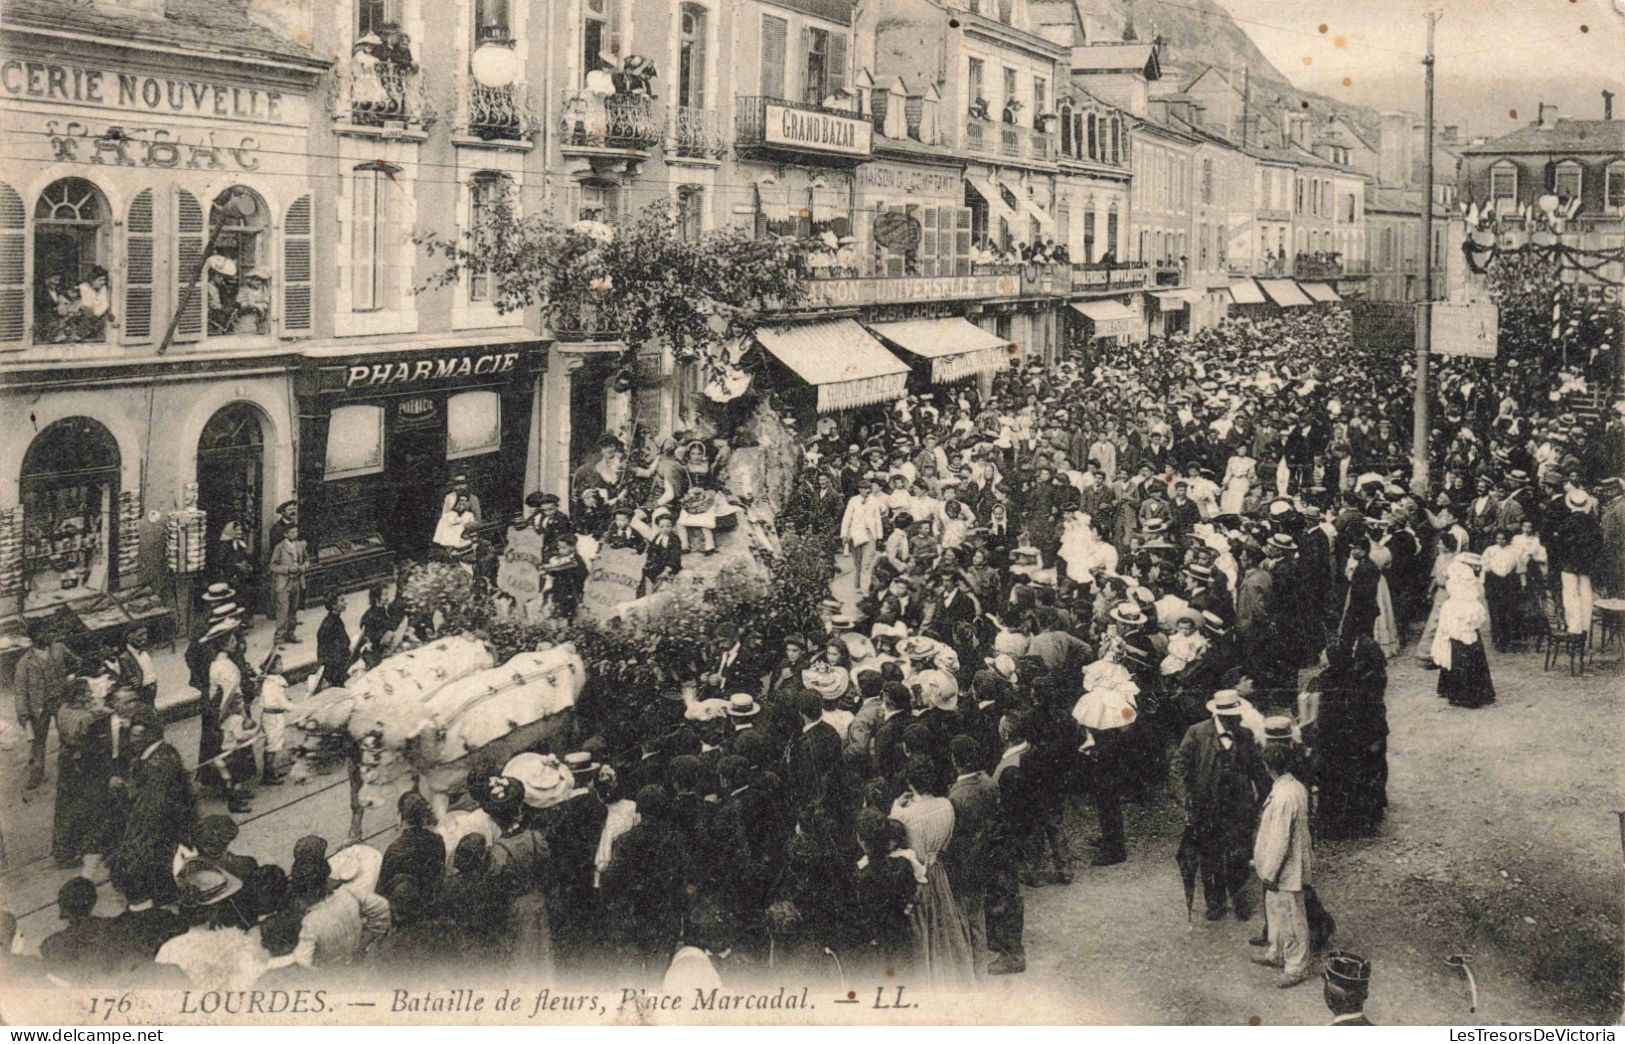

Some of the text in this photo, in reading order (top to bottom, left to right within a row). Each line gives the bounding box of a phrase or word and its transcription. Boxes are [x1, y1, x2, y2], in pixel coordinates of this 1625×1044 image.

[1, 60, 283, 120] CERIE NOUVELLE
[46, 119, 262, 171] TABAC
[782, 109, 855, 148] GRAND BAZAR
[876, 277, 976, 298] UNIVERSELLE
[347, 353, 519, 387] PHARMACIE
